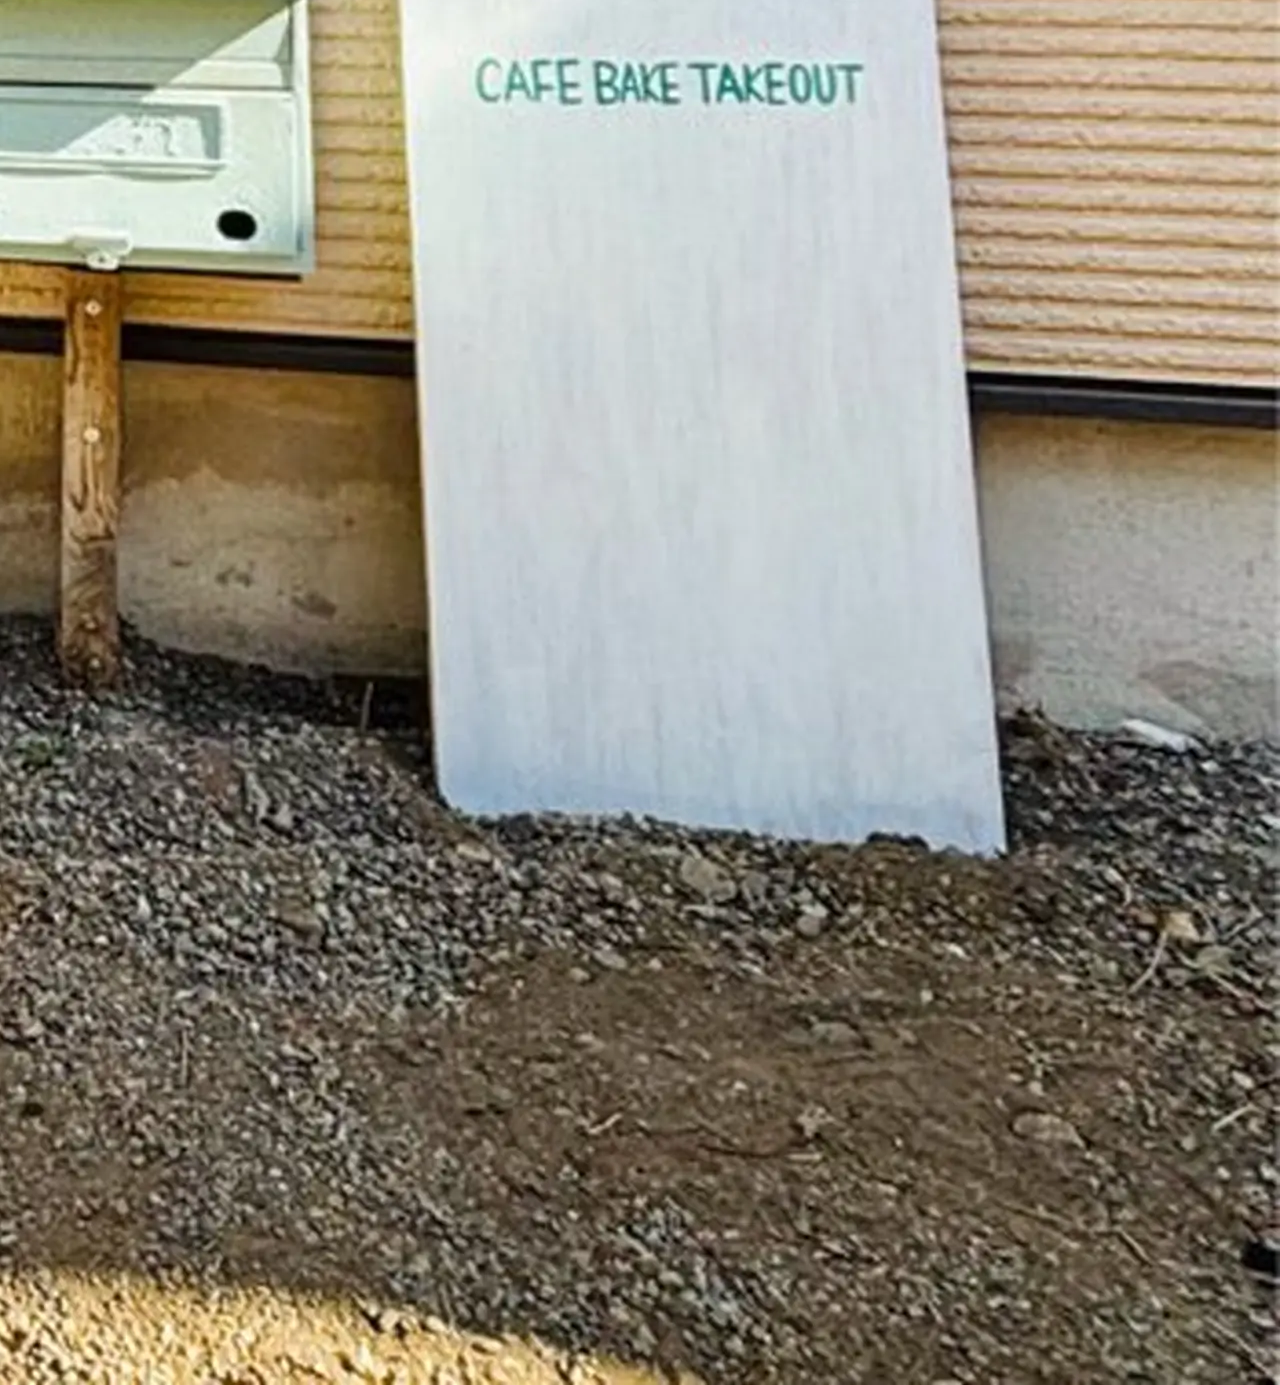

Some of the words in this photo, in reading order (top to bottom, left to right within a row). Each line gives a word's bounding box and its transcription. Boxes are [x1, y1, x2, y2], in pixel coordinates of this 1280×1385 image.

[474, 56, 583, 106] CAFE
[591, 58, 682, 107] BAKE
[686, 60, 865, 107] TAKEOUT
